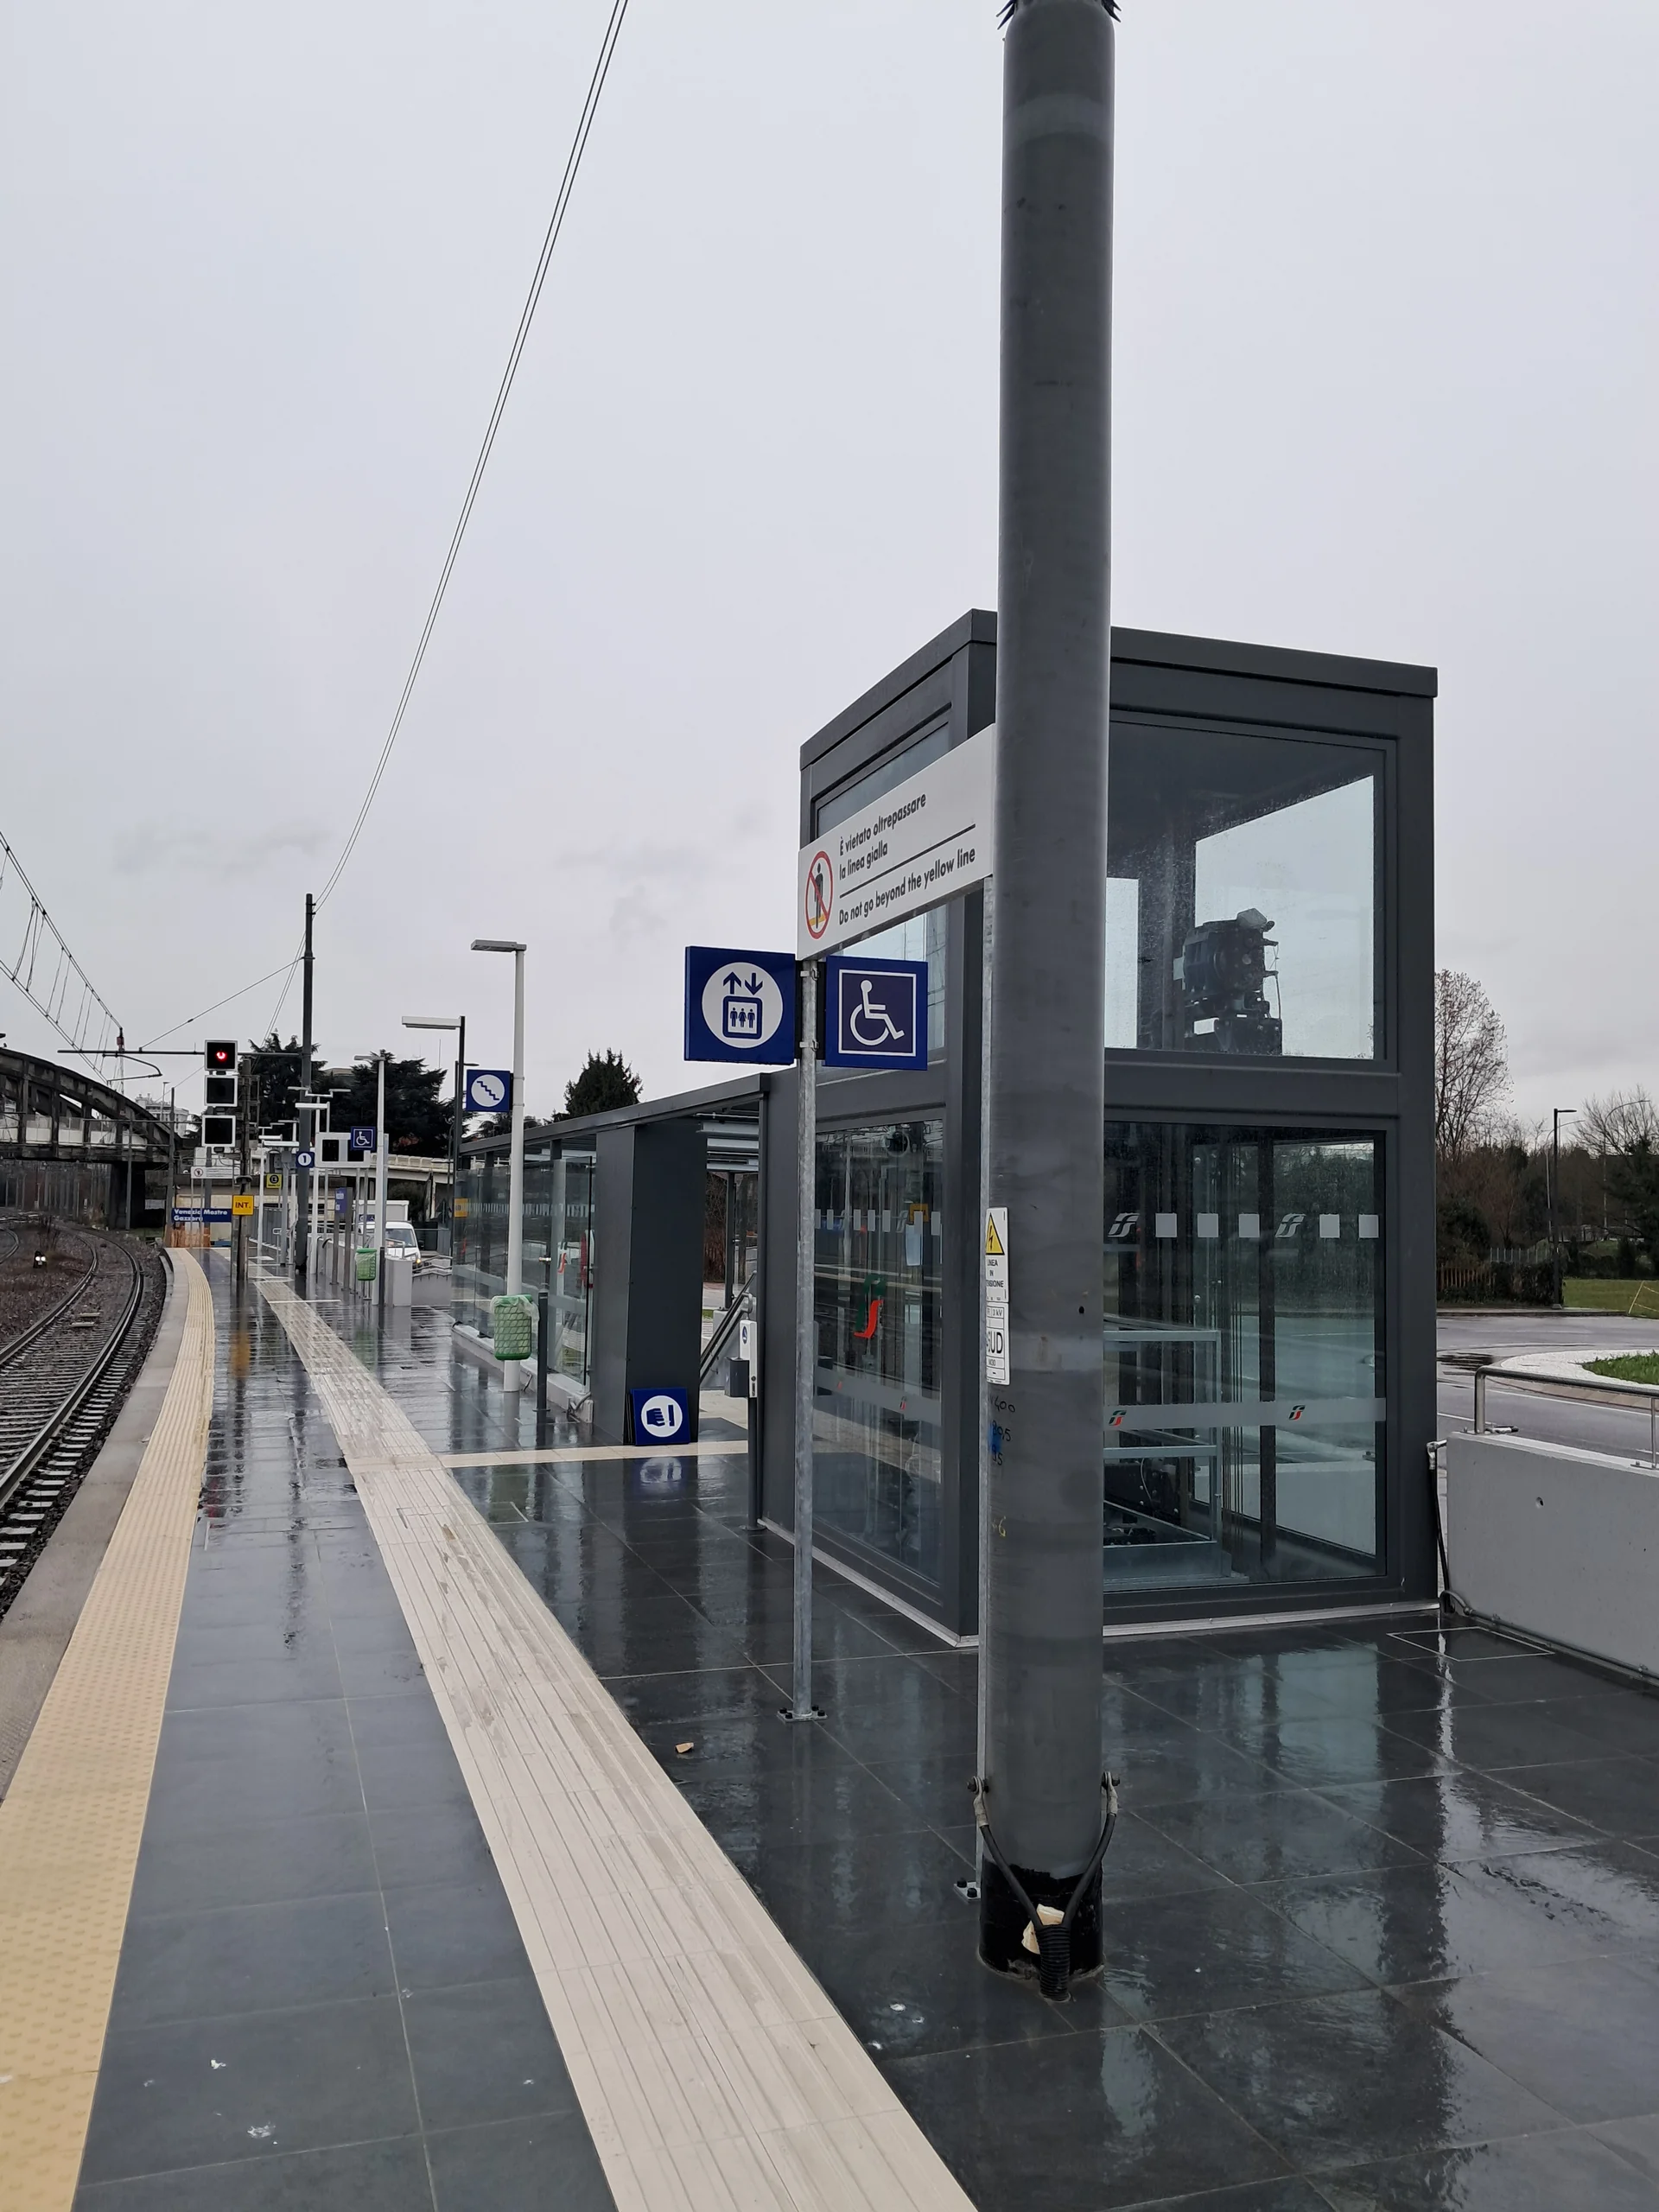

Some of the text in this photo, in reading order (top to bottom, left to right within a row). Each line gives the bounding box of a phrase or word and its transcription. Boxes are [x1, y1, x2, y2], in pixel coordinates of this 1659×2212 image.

[839, 793, 927, 856] È vietato oltrepassare
[839, 841, 888, 880] la linea gialla
[839, 847, 976, 925] Do not go beyond the yellow line
